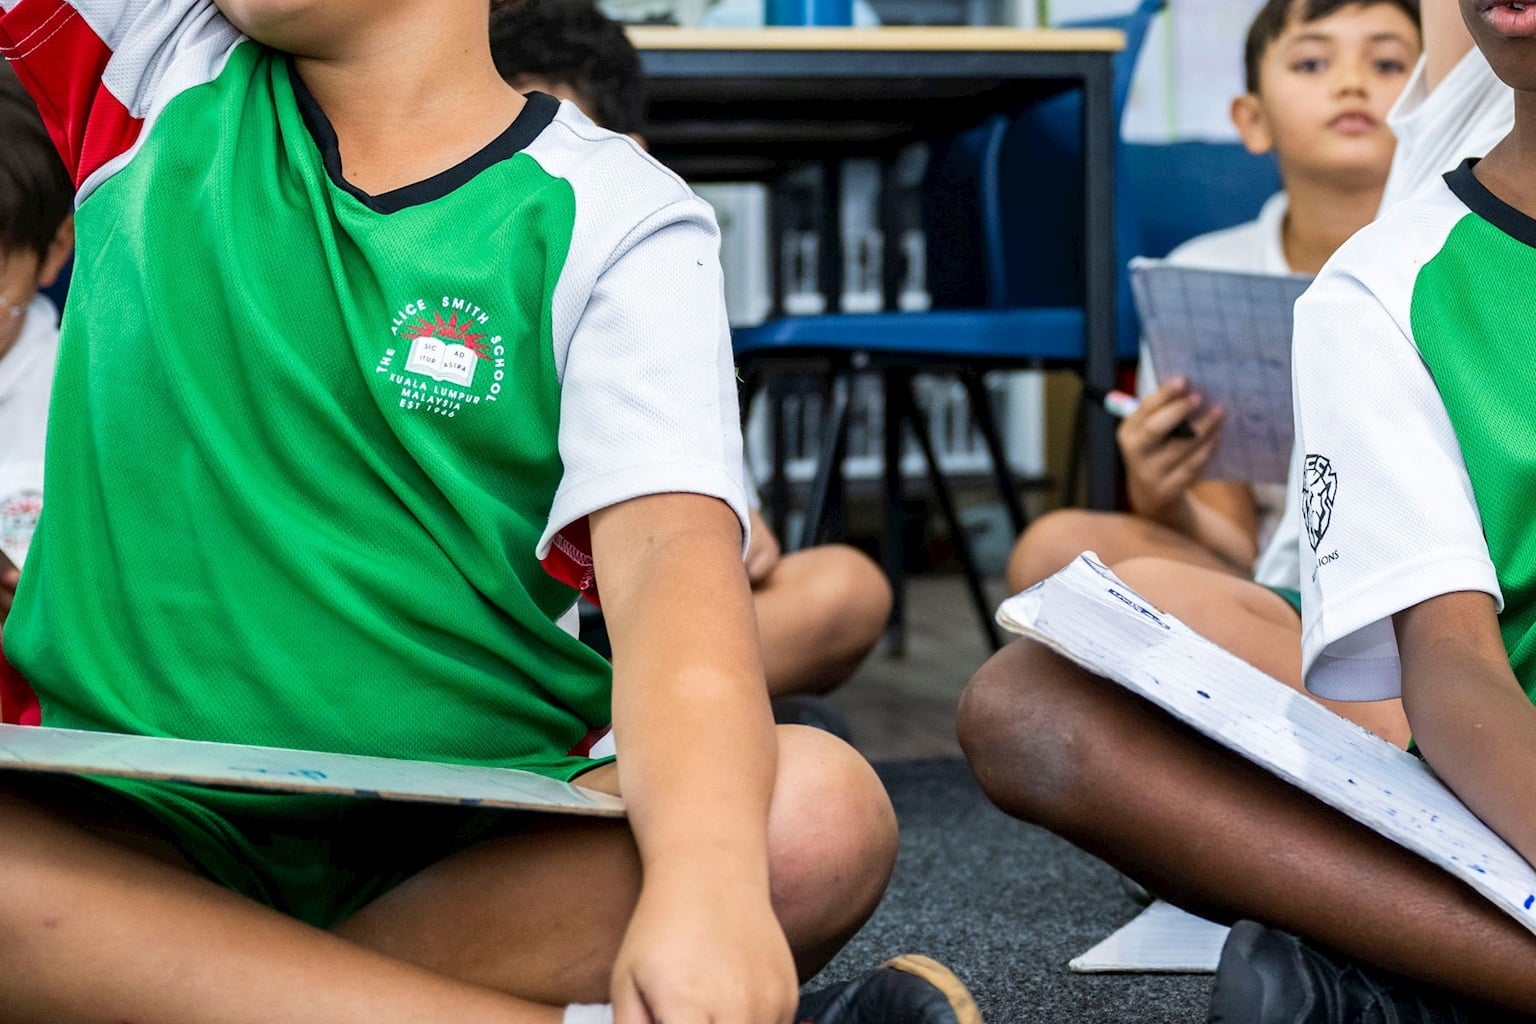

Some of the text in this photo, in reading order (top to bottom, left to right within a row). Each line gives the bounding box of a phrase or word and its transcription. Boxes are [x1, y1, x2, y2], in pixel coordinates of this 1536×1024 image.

[376, 296, 505, 402] THE ALICE SMITH SCHOOL
[389, 373, 480, 405] KUALA LUMPUR
[401, 388, 460, 410] MALAYSIA
[399, 398, 420, 410] EST
[1316, 549, 1340, 569] IONS
